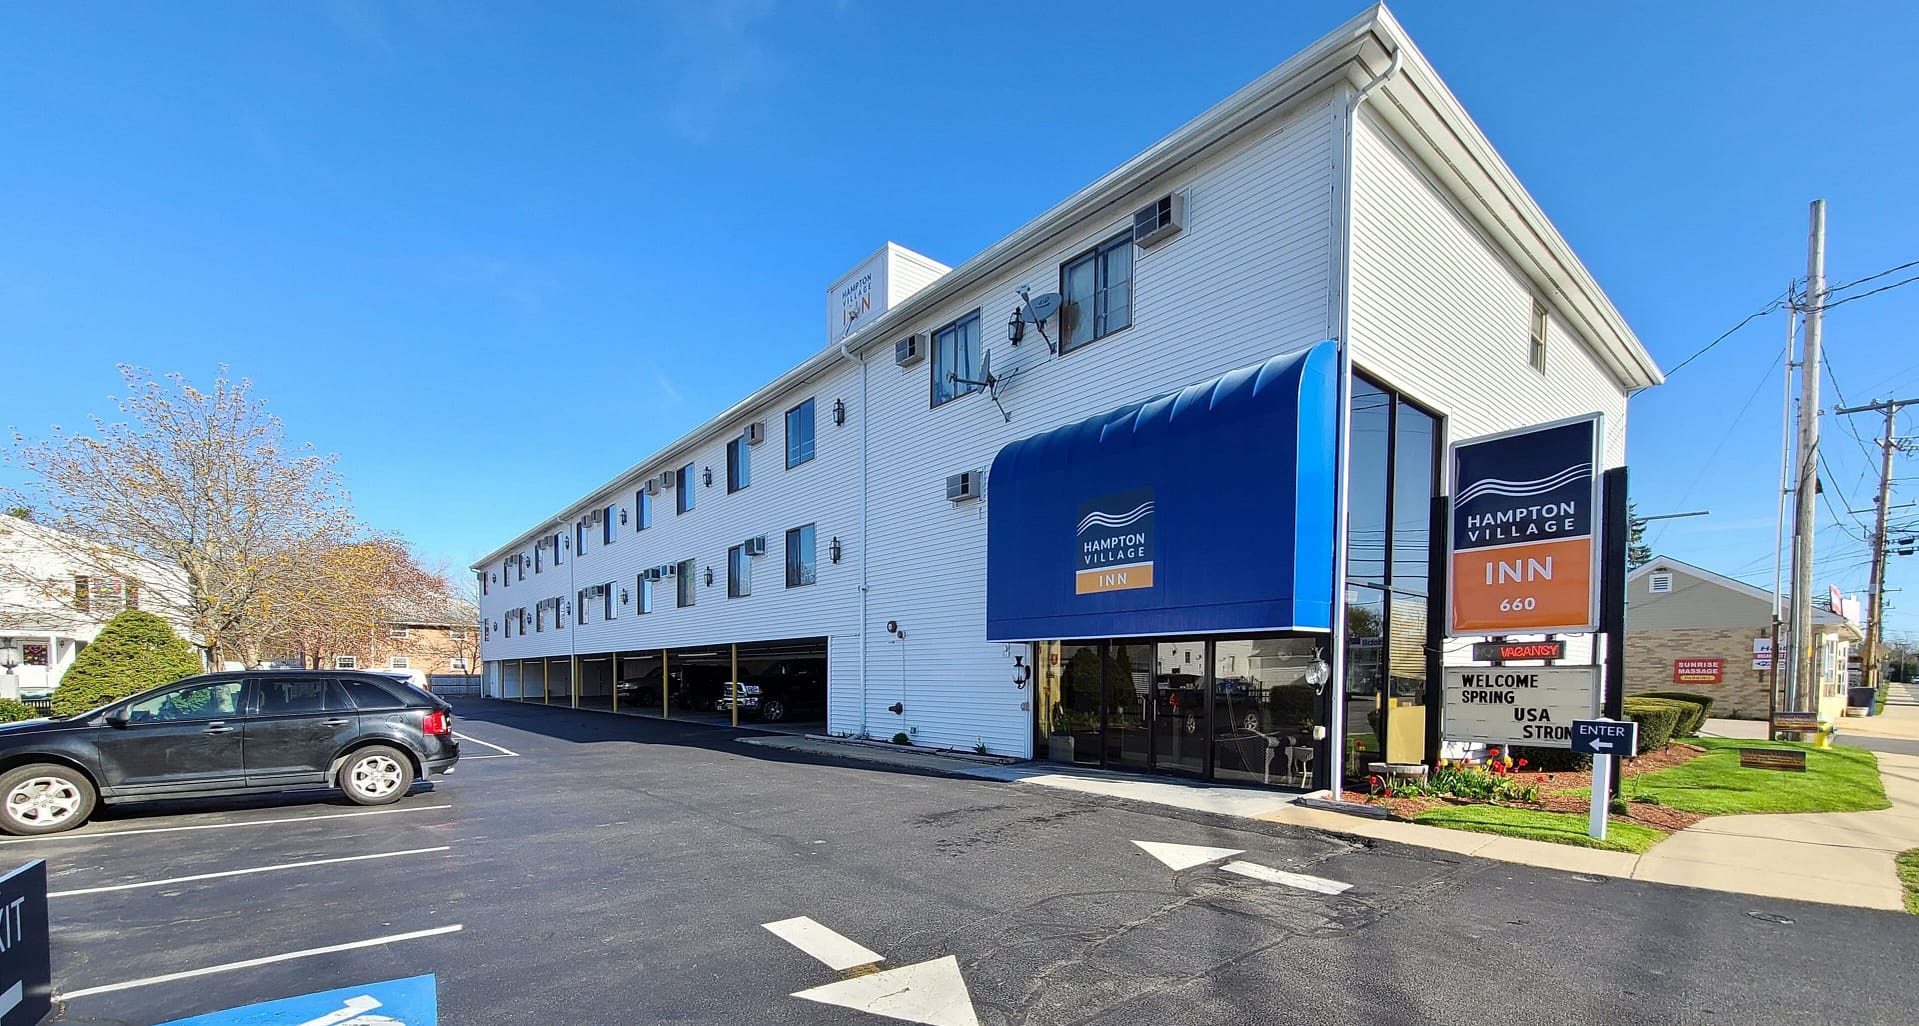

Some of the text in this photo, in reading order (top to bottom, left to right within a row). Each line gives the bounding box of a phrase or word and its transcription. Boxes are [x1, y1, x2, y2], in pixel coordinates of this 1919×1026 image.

[842, 272, 872, 299] HAMPTON
[843, 282, 872, 307] VILLAGE
[1467, 500, 1575, 528] HAMPTON
[1468, 518, 1574, 542] VILLAGE
[1084, 532, 1145, 553] HAMPTON
[1084, 546, 1145, 565] VILLAGE
[1485, 556, 1552, 585] INN
[1099, 572, 1127, 588] INN
[1500, 597, 1536, 612] 660
[1500, 644, 1559, 658] VACANCY
[1461, 674, 1539, 688] WELCOME
[1461, 690, 1515, 704] SPRING
[1514, 708, 1551, 722] USA
[1580, 724, 1625, 737] ENTER
